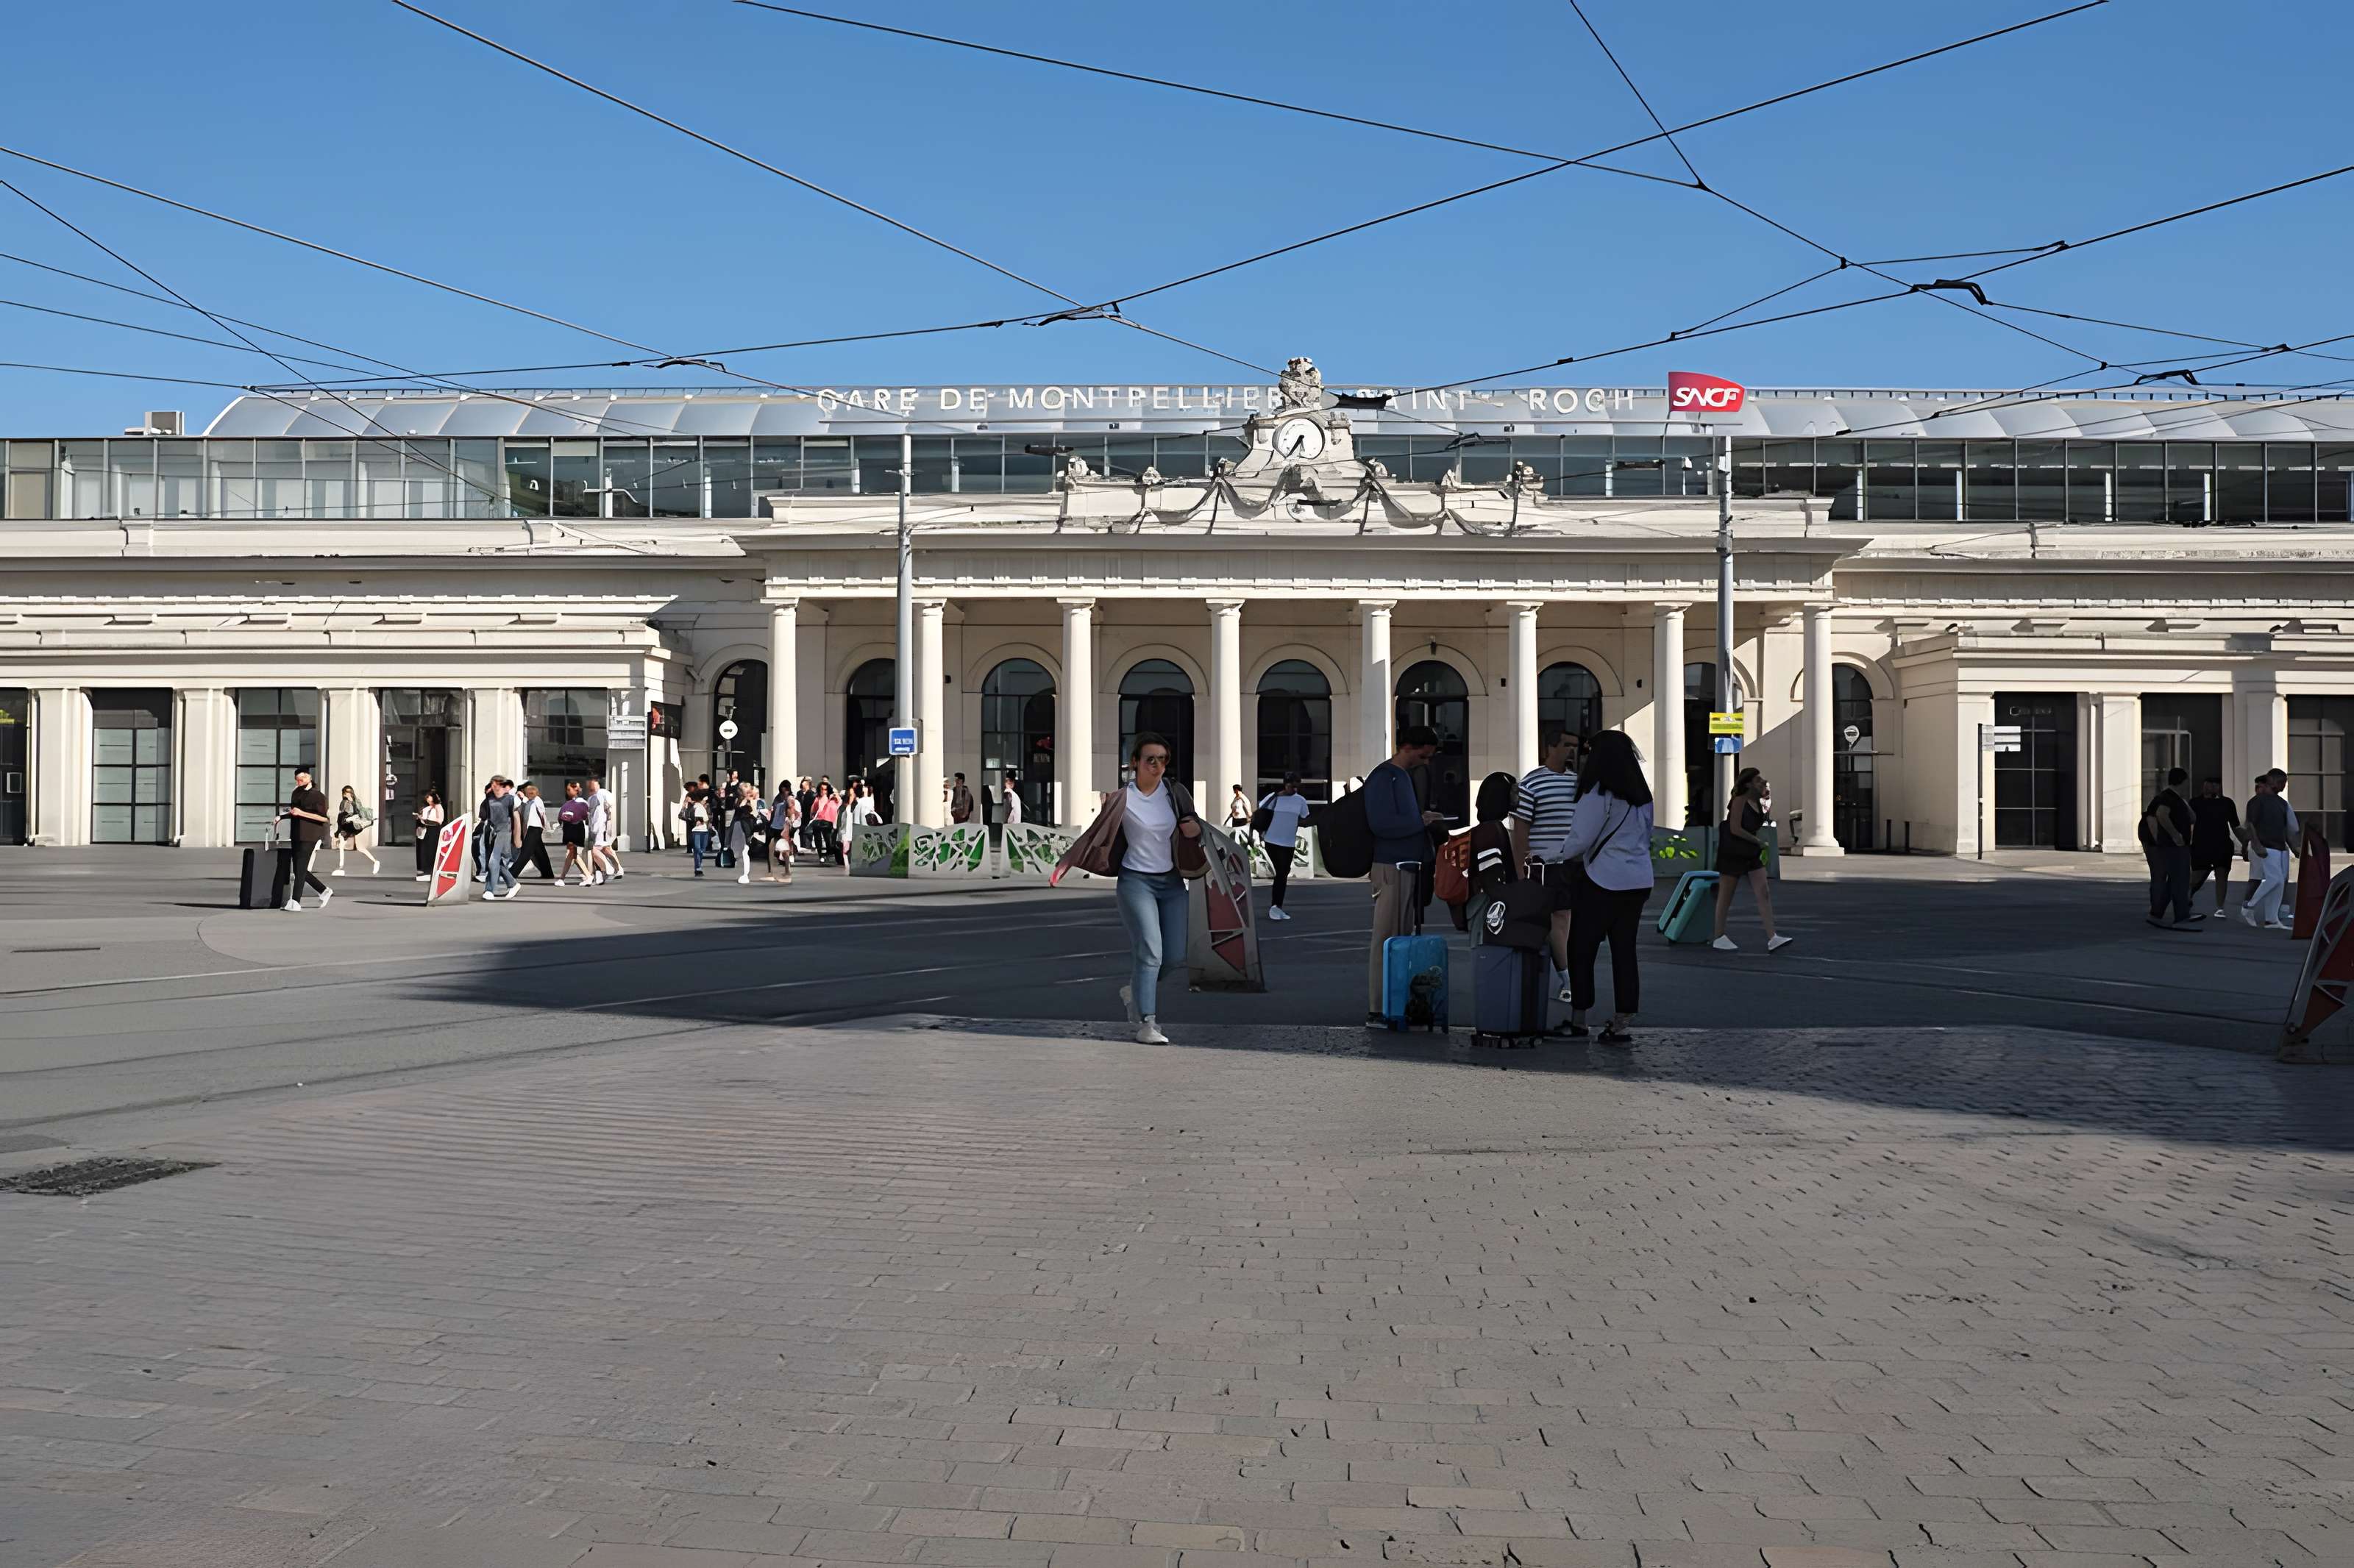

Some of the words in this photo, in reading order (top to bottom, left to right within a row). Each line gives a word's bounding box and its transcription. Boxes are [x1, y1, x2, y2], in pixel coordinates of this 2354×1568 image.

[941, 388, 986, 410] DE
[1529, 388, 1634, 413] ROCH
[1673, 387, 1740, 407] SNCF
